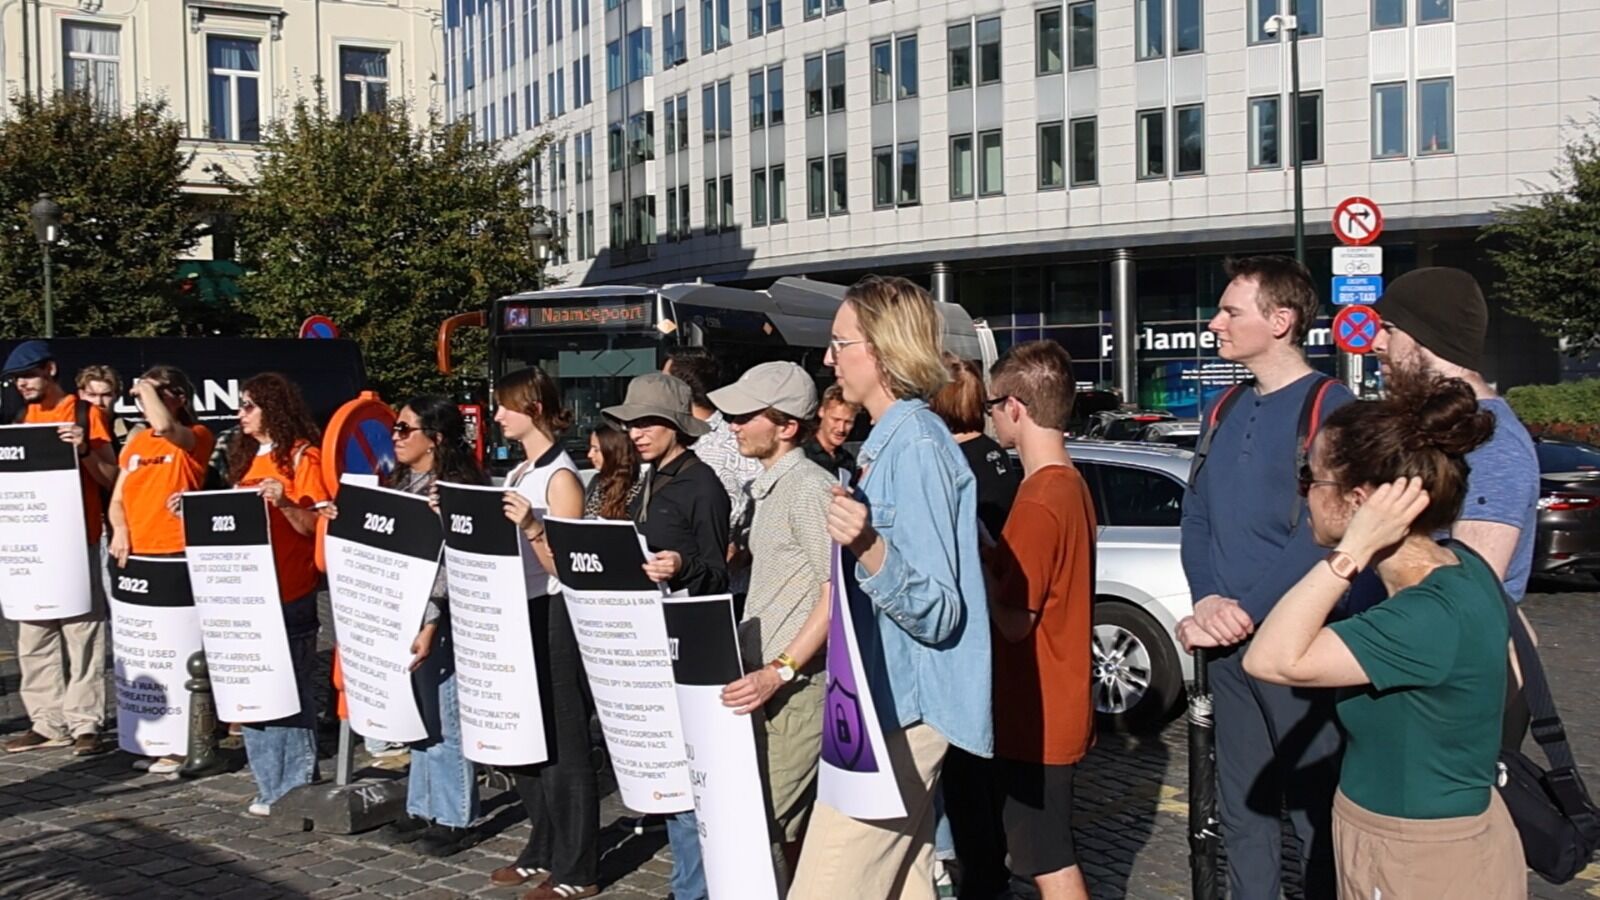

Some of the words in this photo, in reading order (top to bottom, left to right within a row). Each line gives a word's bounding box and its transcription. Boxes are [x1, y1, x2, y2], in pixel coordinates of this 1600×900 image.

[541, 305, 641, 324] Naamsepoort
[212, 515, 236, 531] 2023
[363, 512, 396, 535] 2024
[450, 513, 473, 535] 2025
[569, 552, 604, 573] 2026
[117, 576, 149, 594] 2022
[147, 649, 177, 659] USED
[149, 660, 174, 670] WAR
